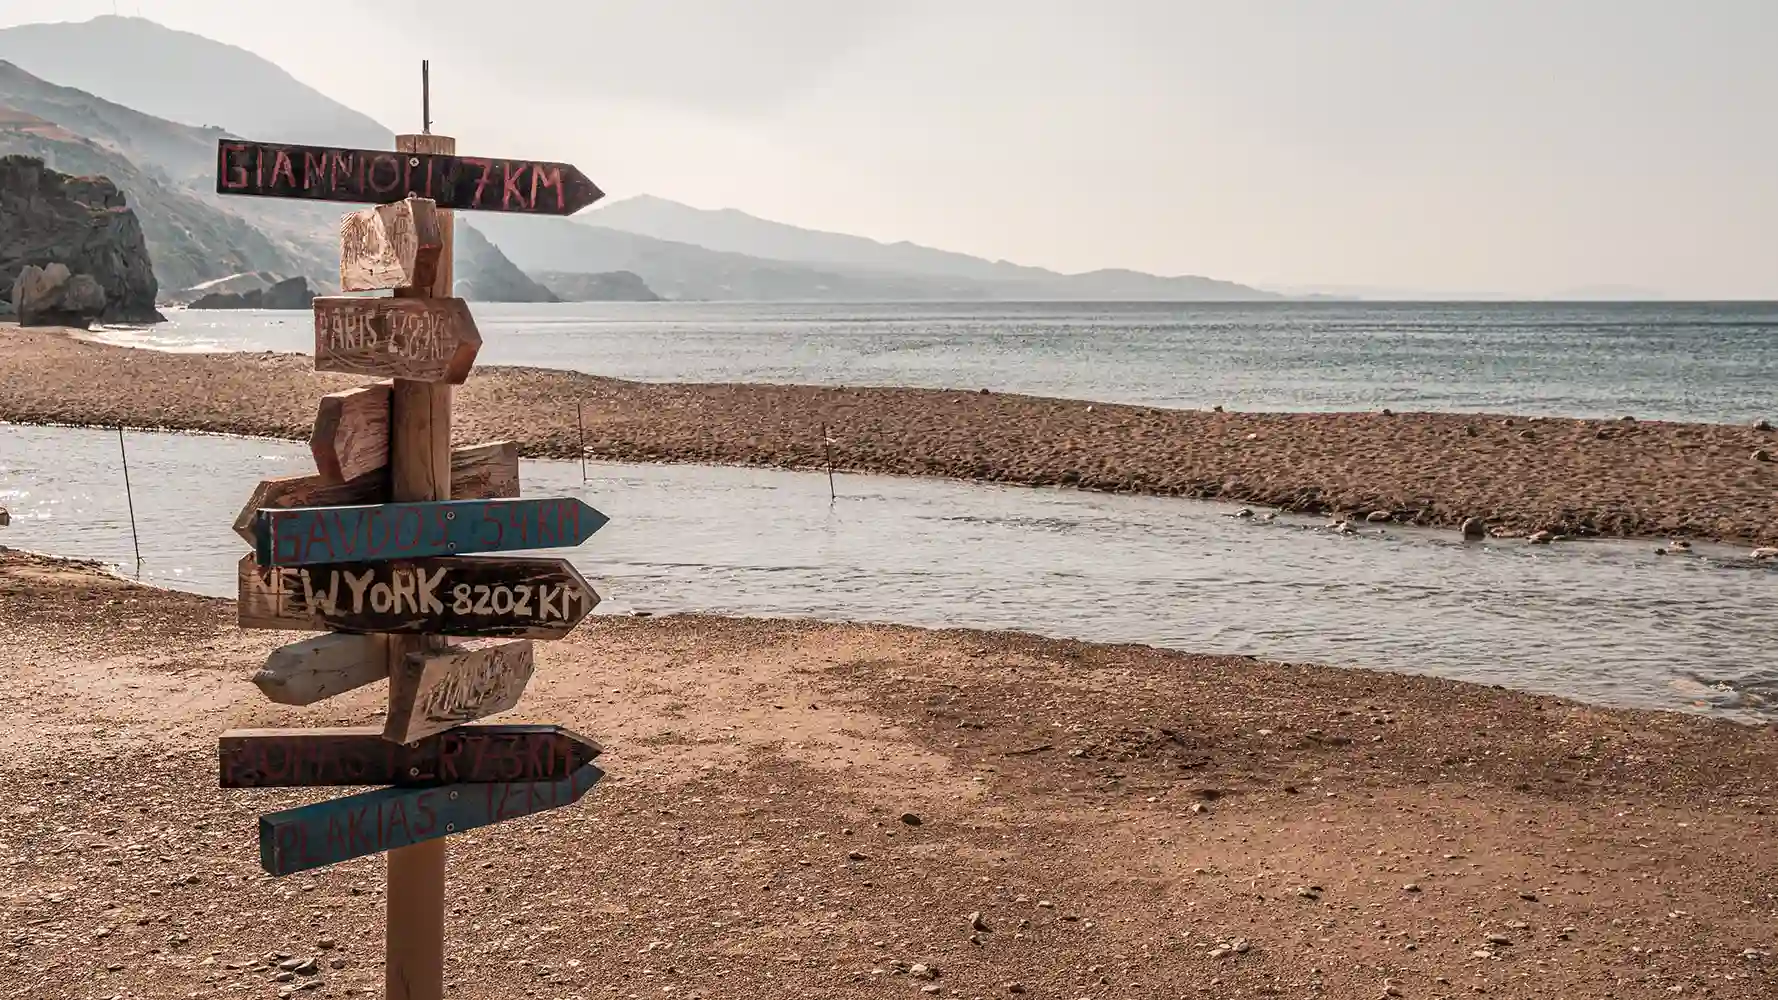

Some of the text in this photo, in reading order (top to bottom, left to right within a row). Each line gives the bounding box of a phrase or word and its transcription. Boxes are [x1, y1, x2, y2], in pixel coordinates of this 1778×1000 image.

[318, 306, 377, 352] PARIS
[273, 505, 448, 563] GAVDOS
[277, 791, 437, 872] PLAKIAS
